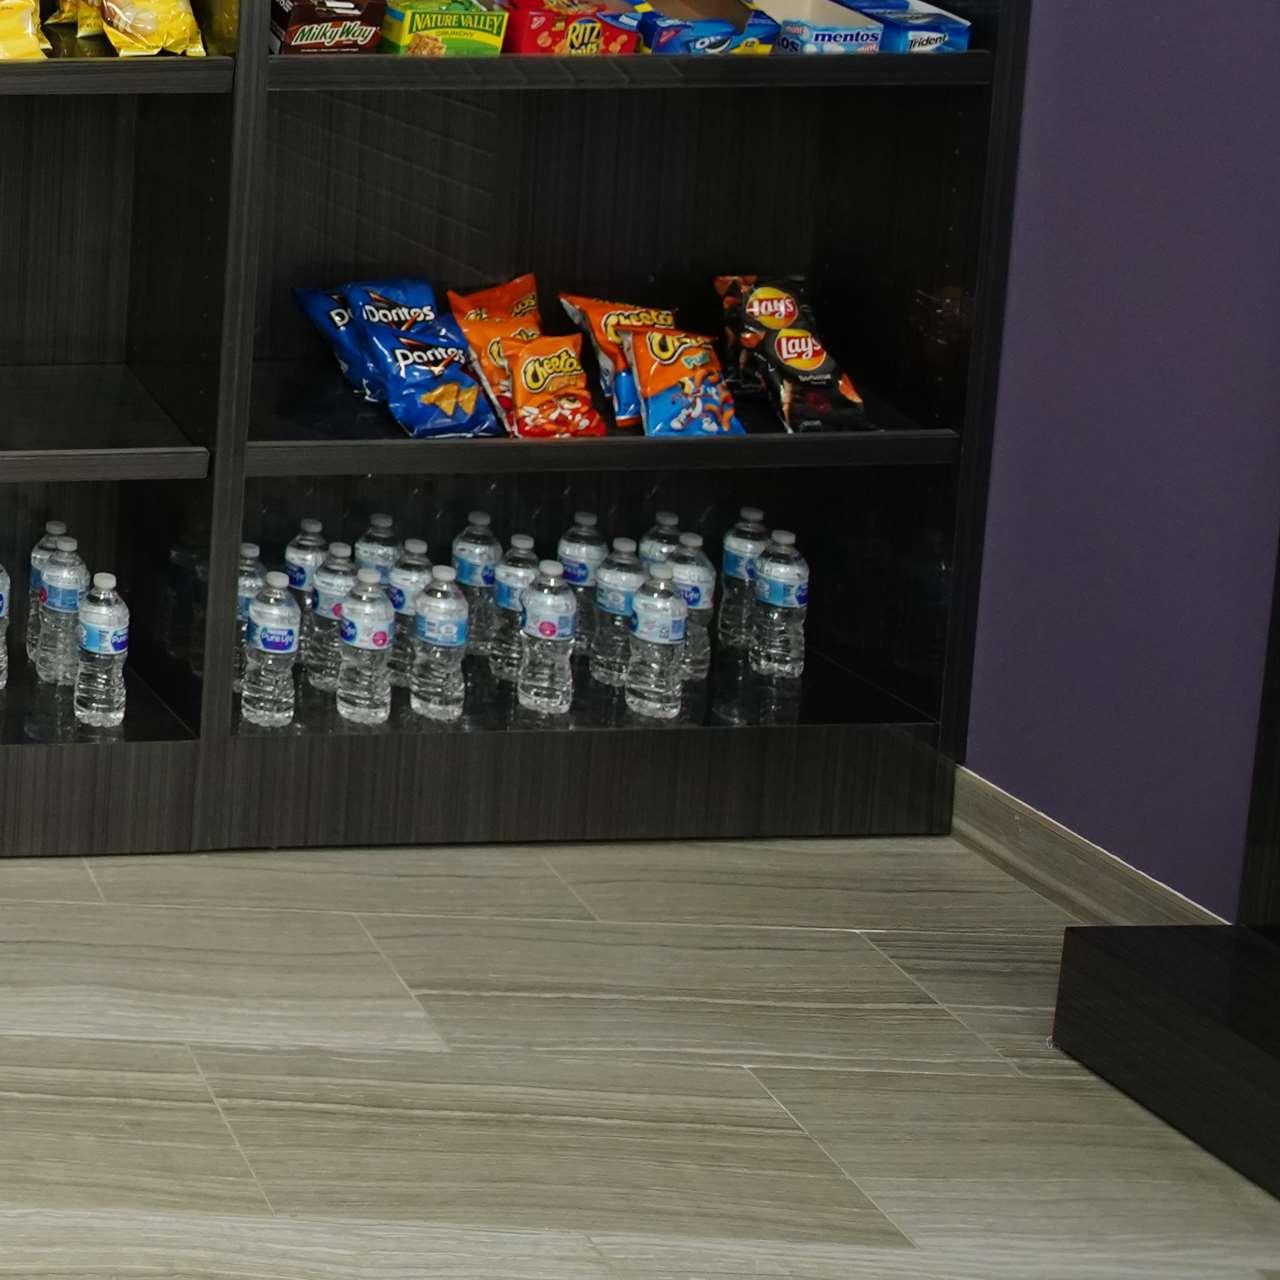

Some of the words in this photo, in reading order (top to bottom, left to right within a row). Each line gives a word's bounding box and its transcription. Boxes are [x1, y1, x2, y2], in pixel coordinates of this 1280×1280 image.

[412, 14, 458, 33] NATURE
[460, 13, 503, 34] VALLEY
[567, 22, 602, 45] RITZ
[813, 31, 881, 43] mentos
[908, 33, 949, 50] Trident
[521, 349, 582, 393] Cheeto
